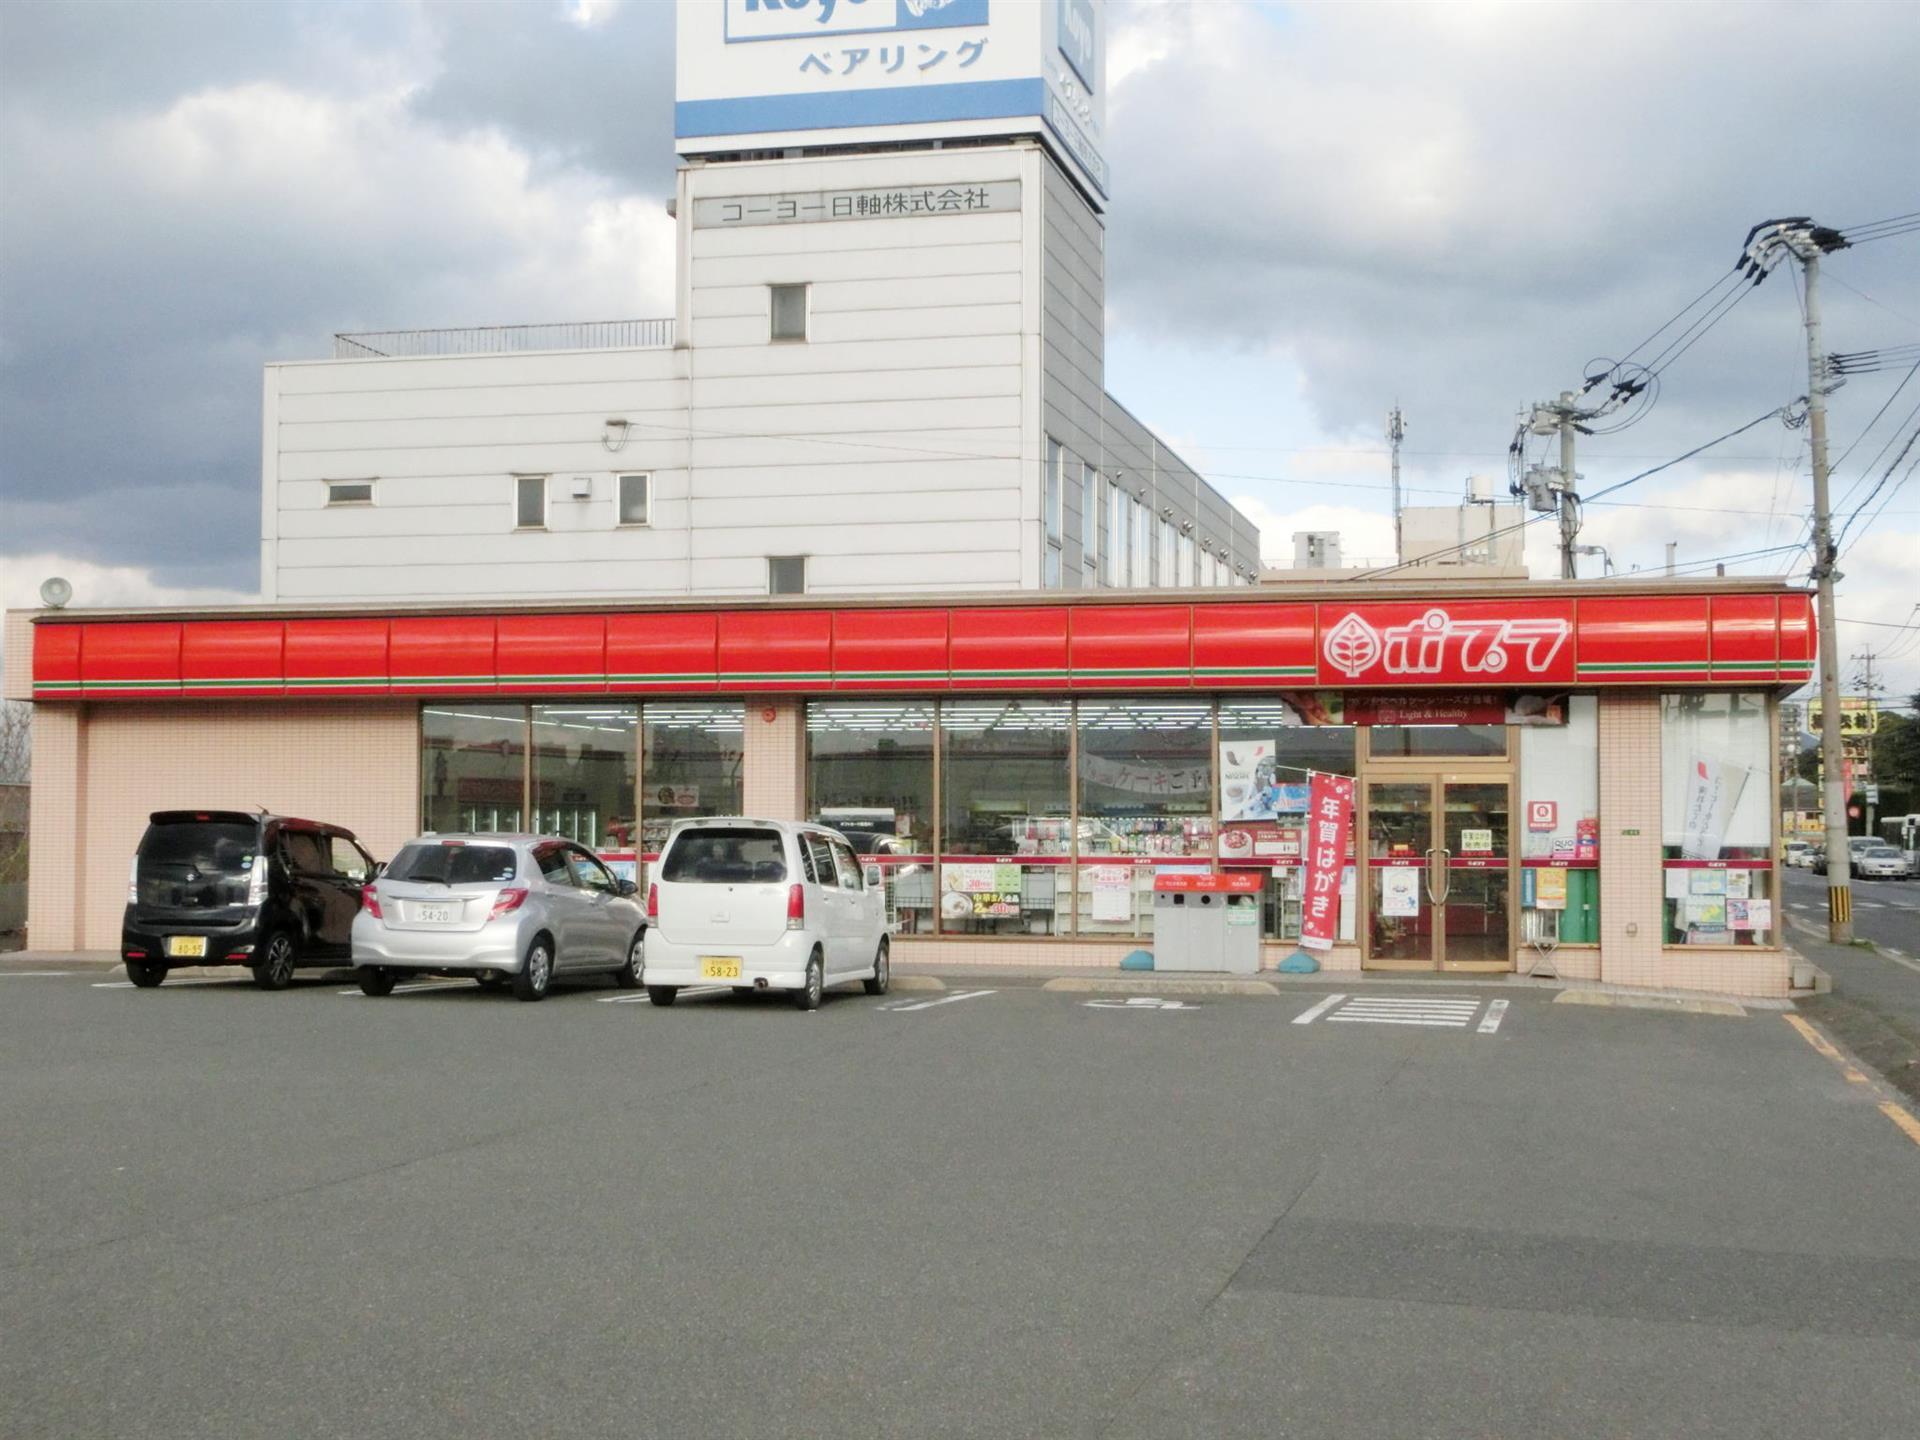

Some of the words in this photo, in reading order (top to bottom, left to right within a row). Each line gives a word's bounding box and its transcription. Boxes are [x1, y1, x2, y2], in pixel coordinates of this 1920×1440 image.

[799, 38, 989, 75] ベアリング
[722, 187, 990, 222] コーヨー日軸株式会社
[1383, 608, 1570, 674] ポプラ
[1311, 796, 1340, 919] 年賀はがき
[422, 910, 449, 921] 54-20
[710, 966, 738, 977] 58-23
